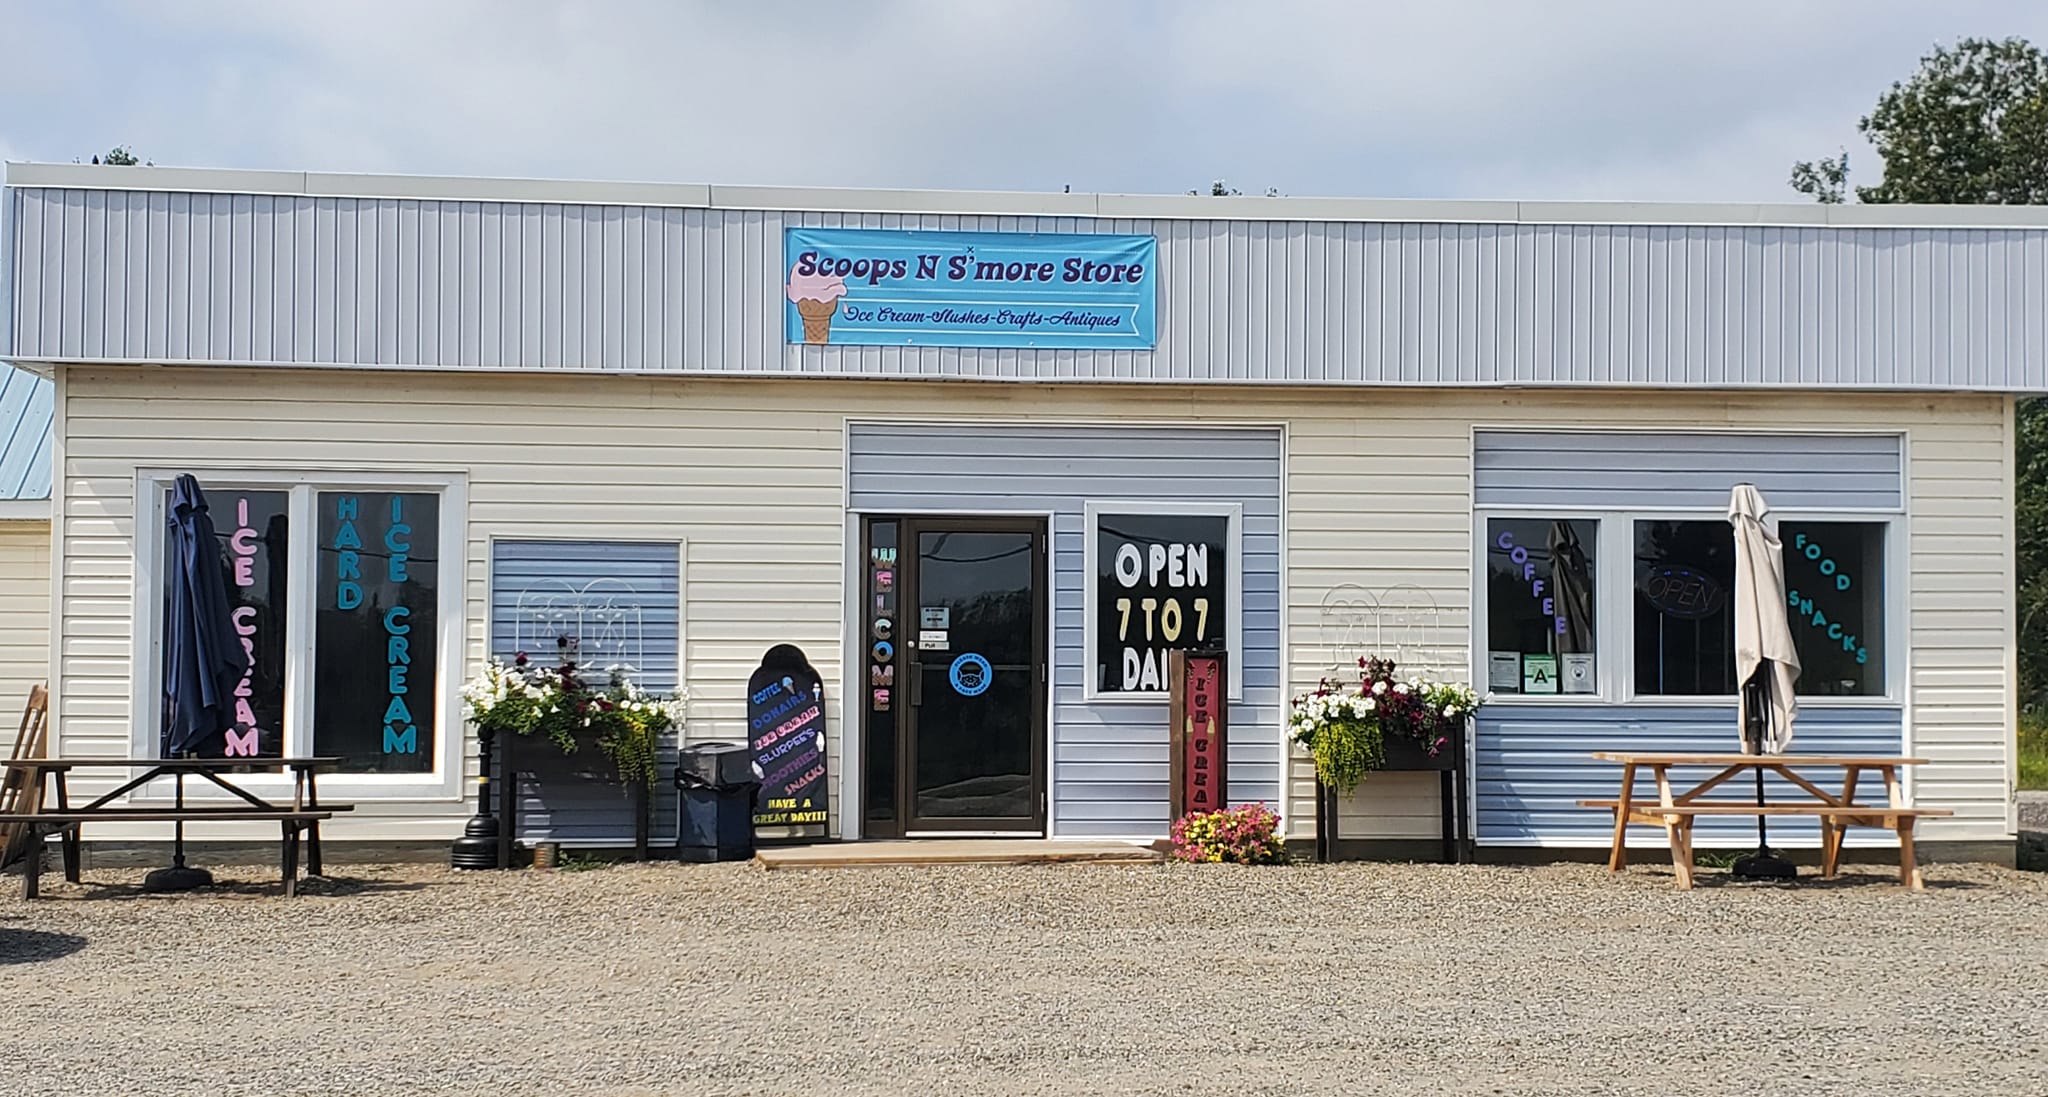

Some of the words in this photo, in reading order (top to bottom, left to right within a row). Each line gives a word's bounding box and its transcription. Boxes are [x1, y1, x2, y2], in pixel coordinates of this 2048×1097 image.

[798, 251, 906, 285] Scoops
[917, 254, 940, 281] N
[948, 254, 1053, 283] S'more
[1062, 257, 1145, 284] Store
[843, 306, 872, 323] Ice
[230, 498, 258, 587] ICE
[335, 496, 364, 610] HARD
[384, 495, 412, 582] ICE
[1115, 543, 1208, 588] OPEN
[1497, 532, 1567, 635] COFFEE
[1796, 534, 1851, 592] FOOD
[1648, 577, 1718, 609] OPEN
[871, 548, 897, 711] WELCOME
[1116, 598, 1131, 641] 7
[1141, 598, 1182, 641] TO
[1194, 598, 1209, 641] 7
[1788, 590, 1868, 664] SNACKS
[383, 606, 417, 754] CREAM
[1123, 647, 1198, 690] DAI
[1533, 668, 1548, 684] A
[752, 682, 782, 705] COFFEE
[752, 690, 807, 729] DONAIRS
[1195, 678, 1208, 723] ICE
[754, 731, 778, 751] ICE
[760, 748, 818, 789] MOOTHIES
[1193, 739, 1209, 814] CREA
[752, 813, 788, 824] GREAT
[768, 798, 797, 809] HAVE
[803, 798, 812, 808] A
